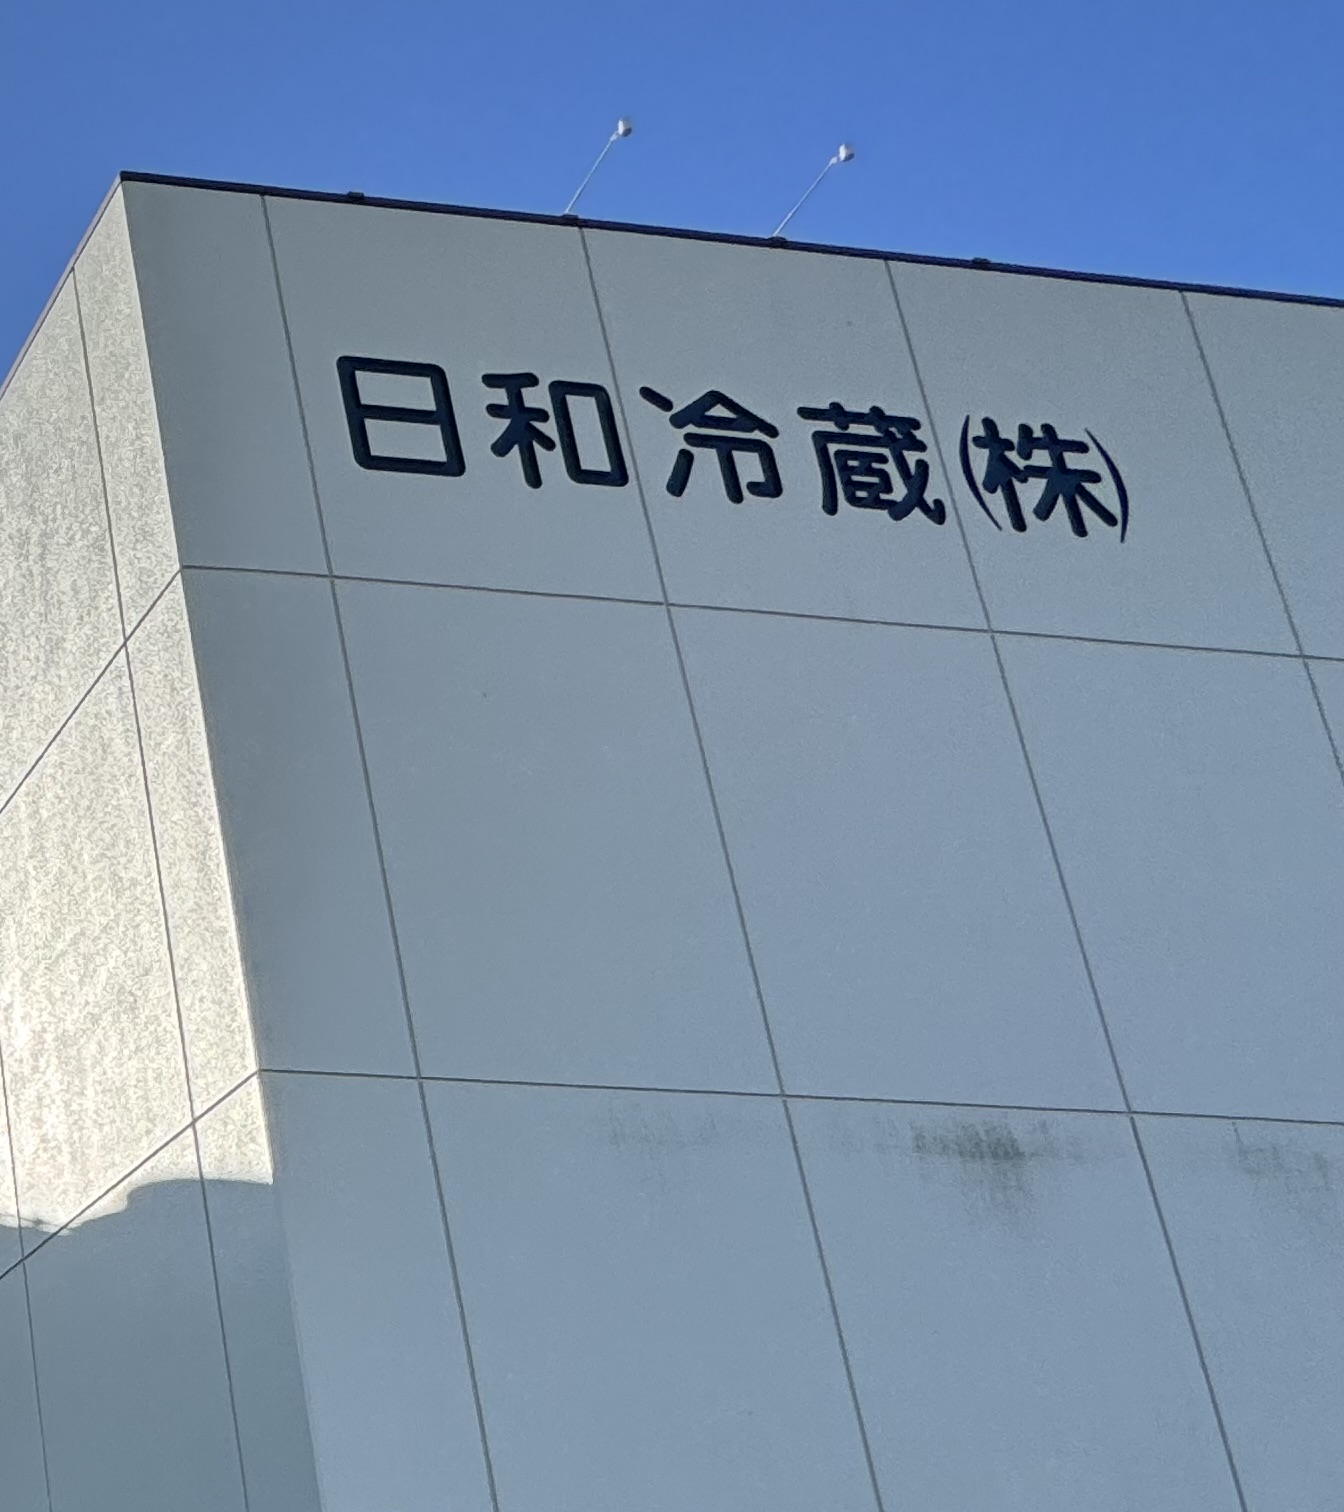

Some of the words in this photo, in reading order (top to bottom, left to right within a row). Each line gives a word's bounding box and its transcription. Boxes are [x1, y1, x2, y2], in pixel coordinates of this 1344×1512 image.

[336, 355, 1129, 543] 日和冷蔵(株)
